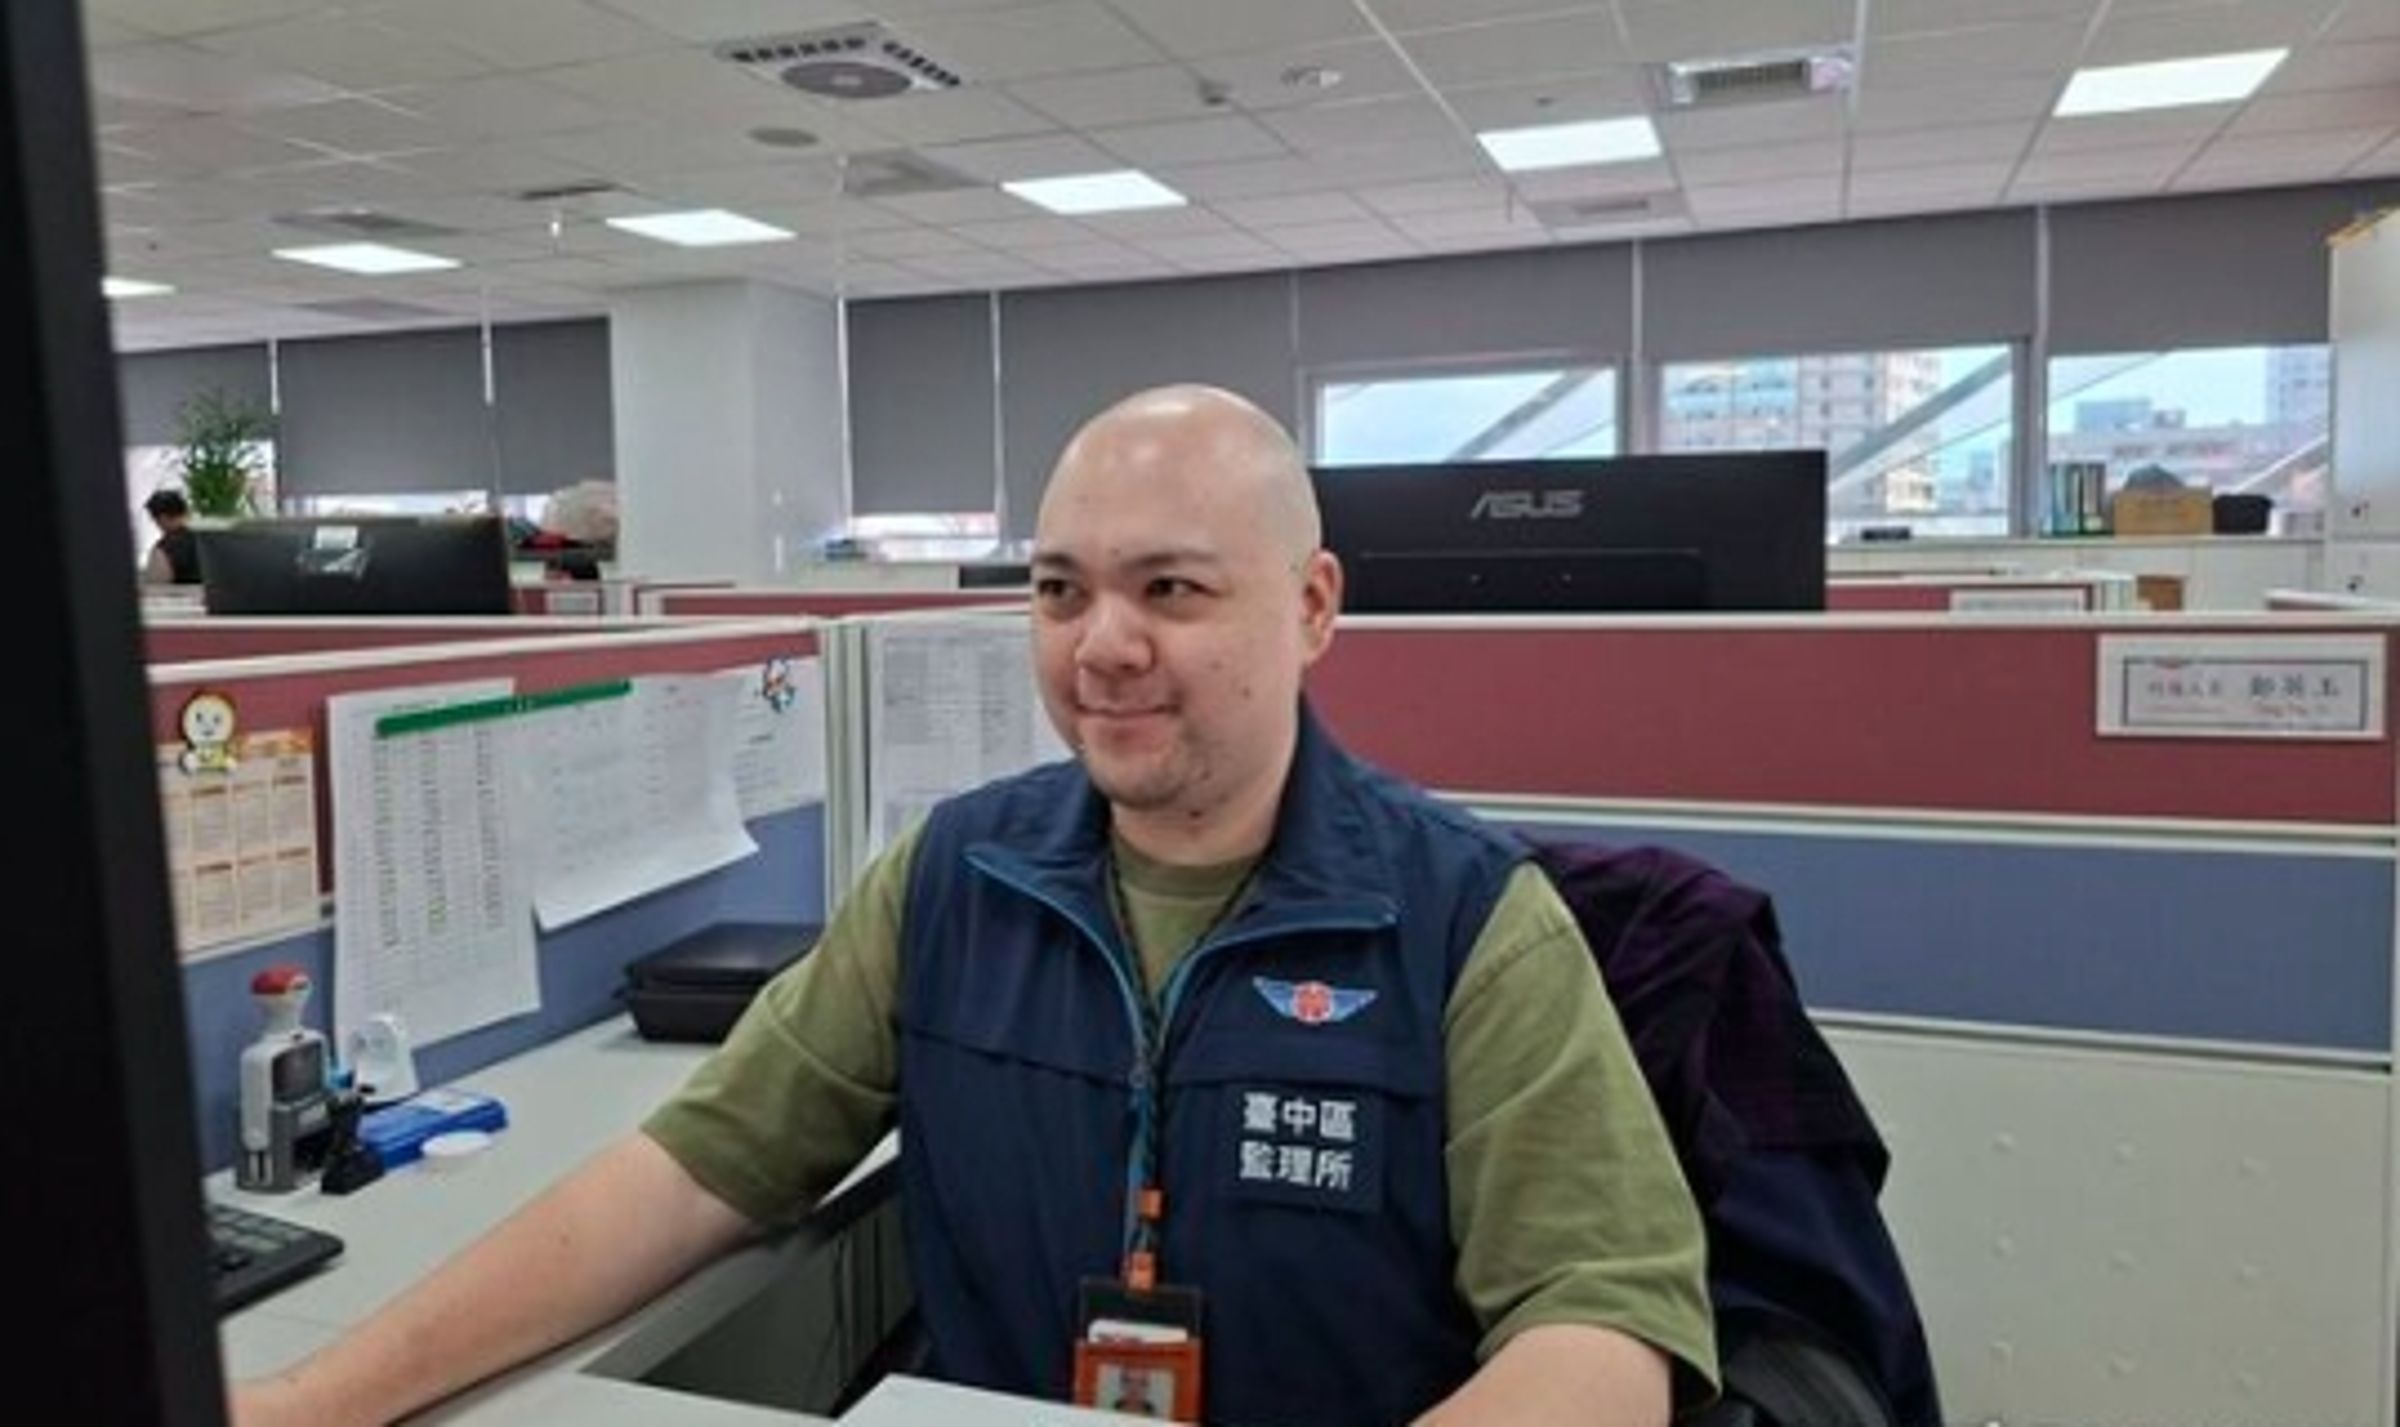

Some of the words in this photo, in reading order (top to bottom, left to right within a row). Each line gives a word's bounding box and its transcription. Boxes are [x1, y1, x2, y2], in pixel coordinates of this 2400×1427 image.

[1470, 490, 1584, 518] ASUS
[1243, 1091, 1357, 1142] 臺中區
[1239, 1140, 1353, 1190] 監理所
